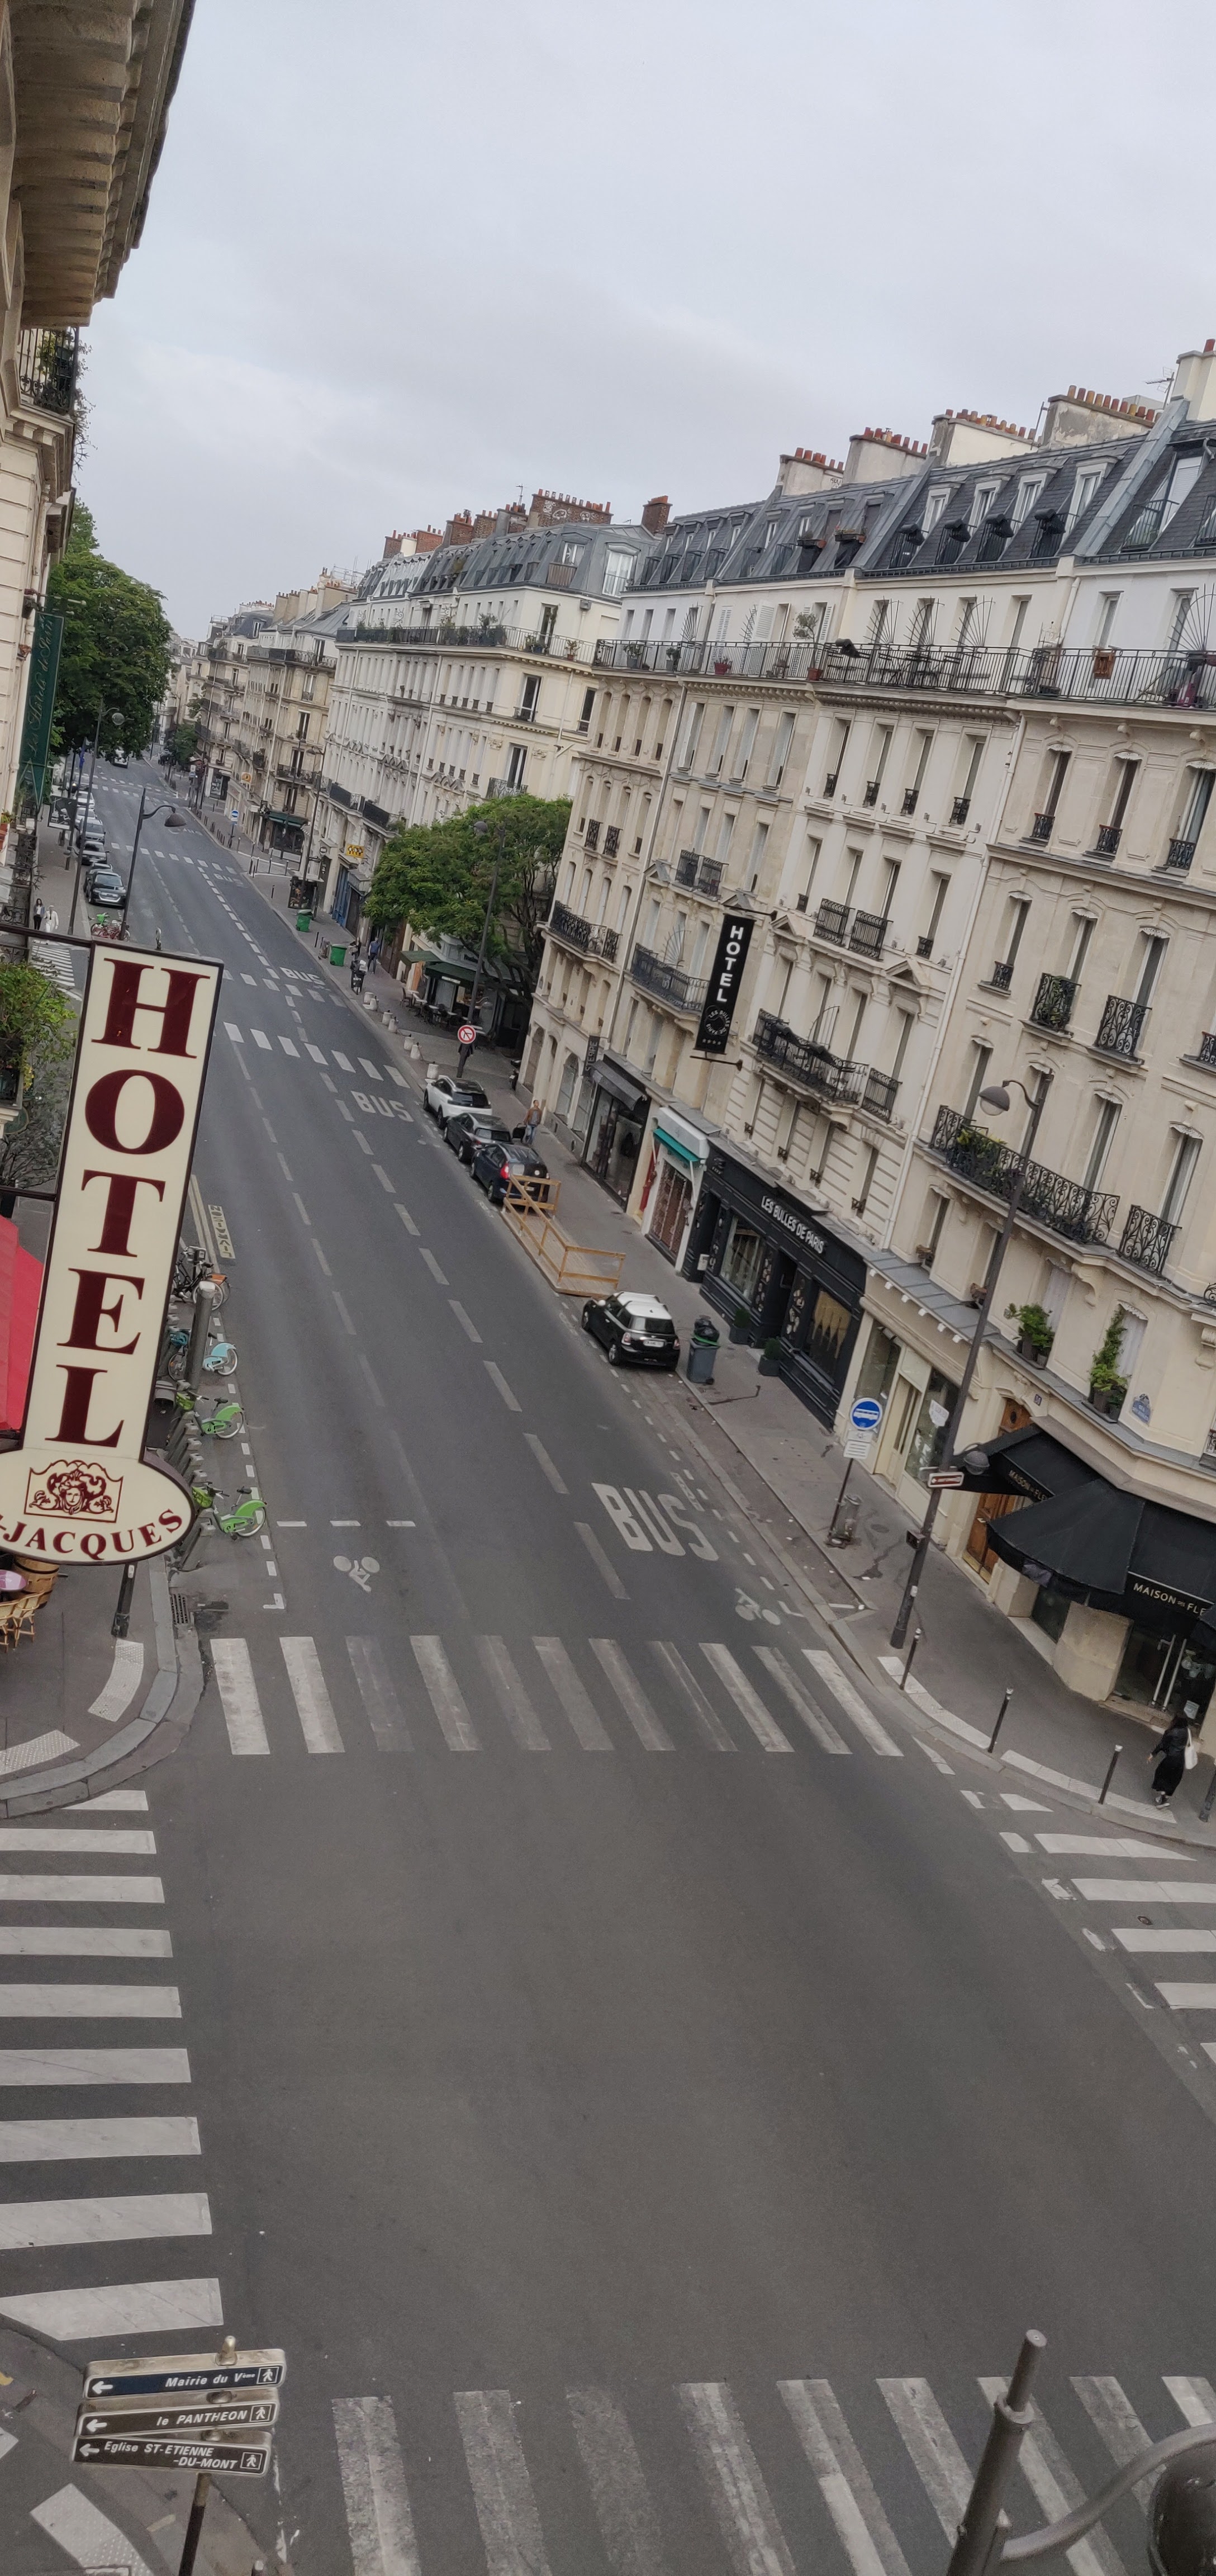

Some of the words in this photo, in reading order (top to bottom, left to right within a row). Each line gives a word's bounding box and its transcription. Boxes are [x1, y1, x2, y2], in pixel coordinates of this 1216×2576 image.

[280, 967, 326, 986] BUS
[716, 925, 744, 1003] HOTEL
[350, 1090, 414, 1122] BUS
[45, 958, 211, 1448] HOTEL
[761, 1196, 775, 1214] LES
[773, 1205, 799, 1232] BULLES
[796, 1223, 808, 1240] DE
[805, 1230, 824, 1254] PARIS
[0, 1509, 182, 1560] -JACQUES
[591, 1483, 719, 1561] BUS
[1133, 1583, 1177, 1604] MAISON
[165, 2376, 207, 2388] Mairie
[213, 2374, 227, 2384] du
[156, 2416, 169, 2426] le
[176, 2410, 248, 2425] PANTHEON
[104, 2441, 139, 2454] Eglise
[144, 2444, 214, 2456] ST-ETIENNE
[173, 2456, 238, 2469] -DU-MONT
